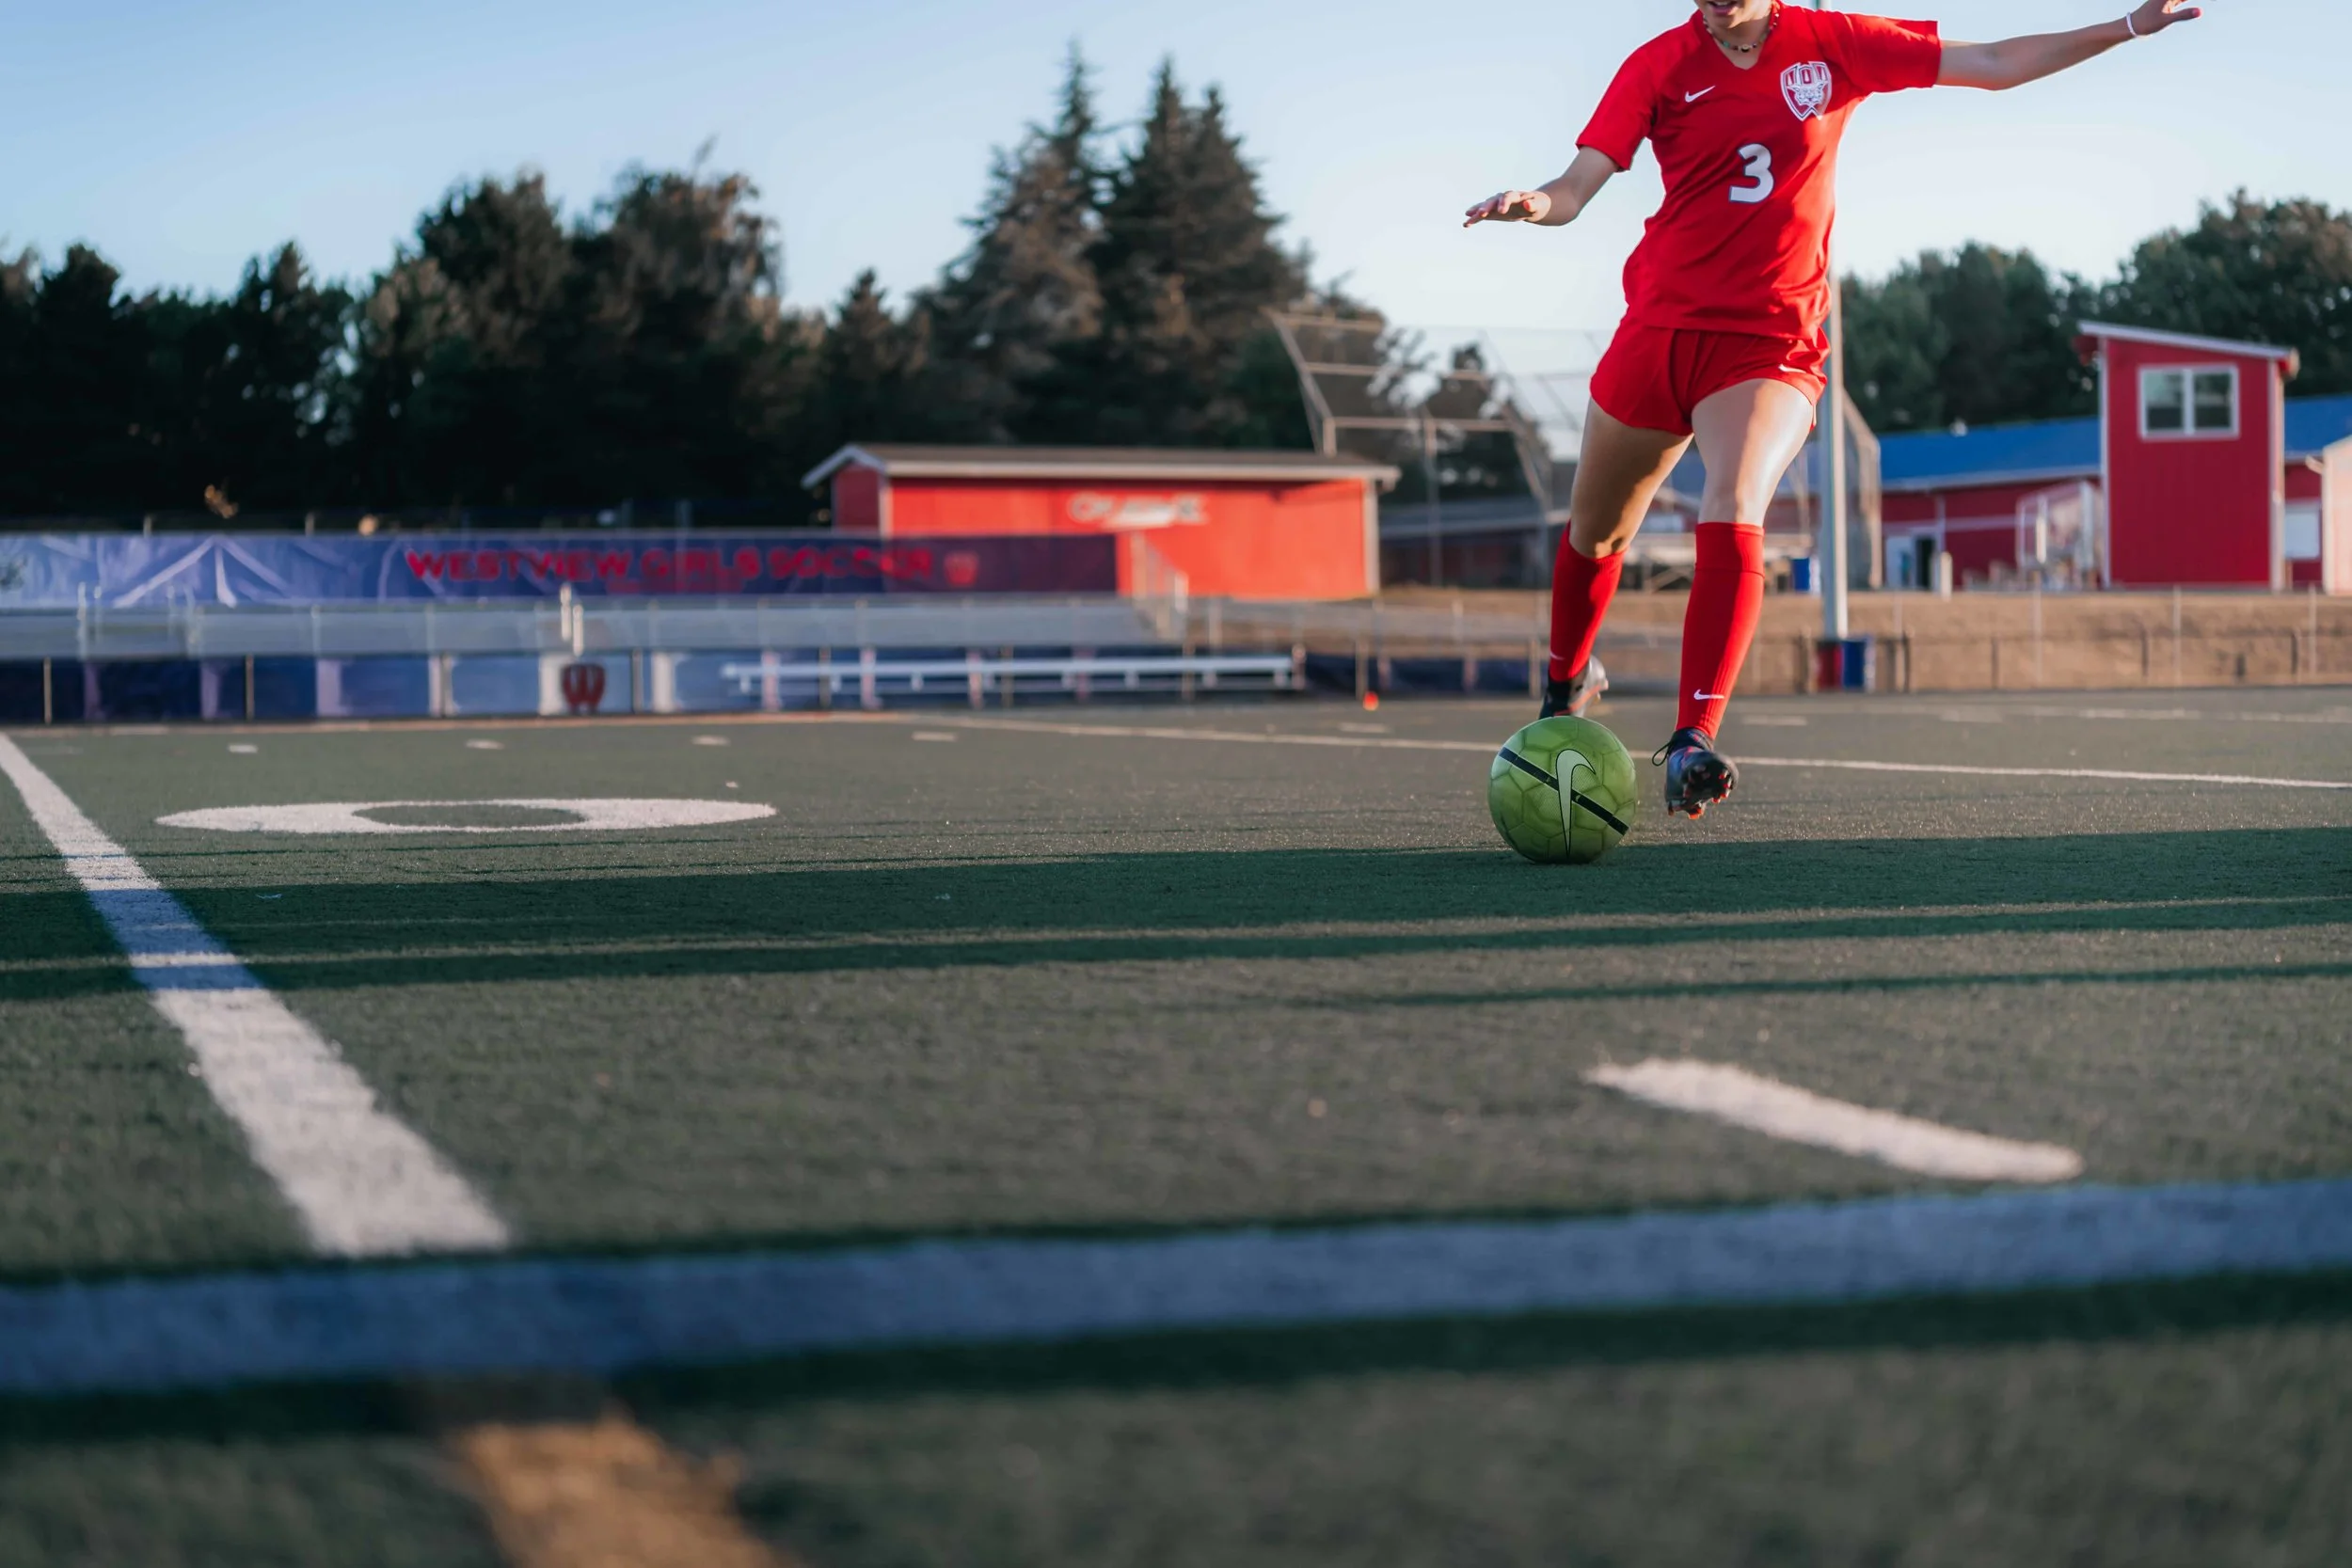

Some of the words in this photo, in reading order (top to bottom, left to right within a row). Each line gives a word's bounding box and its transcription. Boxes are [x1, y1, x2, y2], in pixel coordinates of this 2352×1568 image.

[1729, 143, 1774, 203] 3
[405, 549, 632, 581] WESTVIEW
[641, 546, 760, 579] GIRLS
